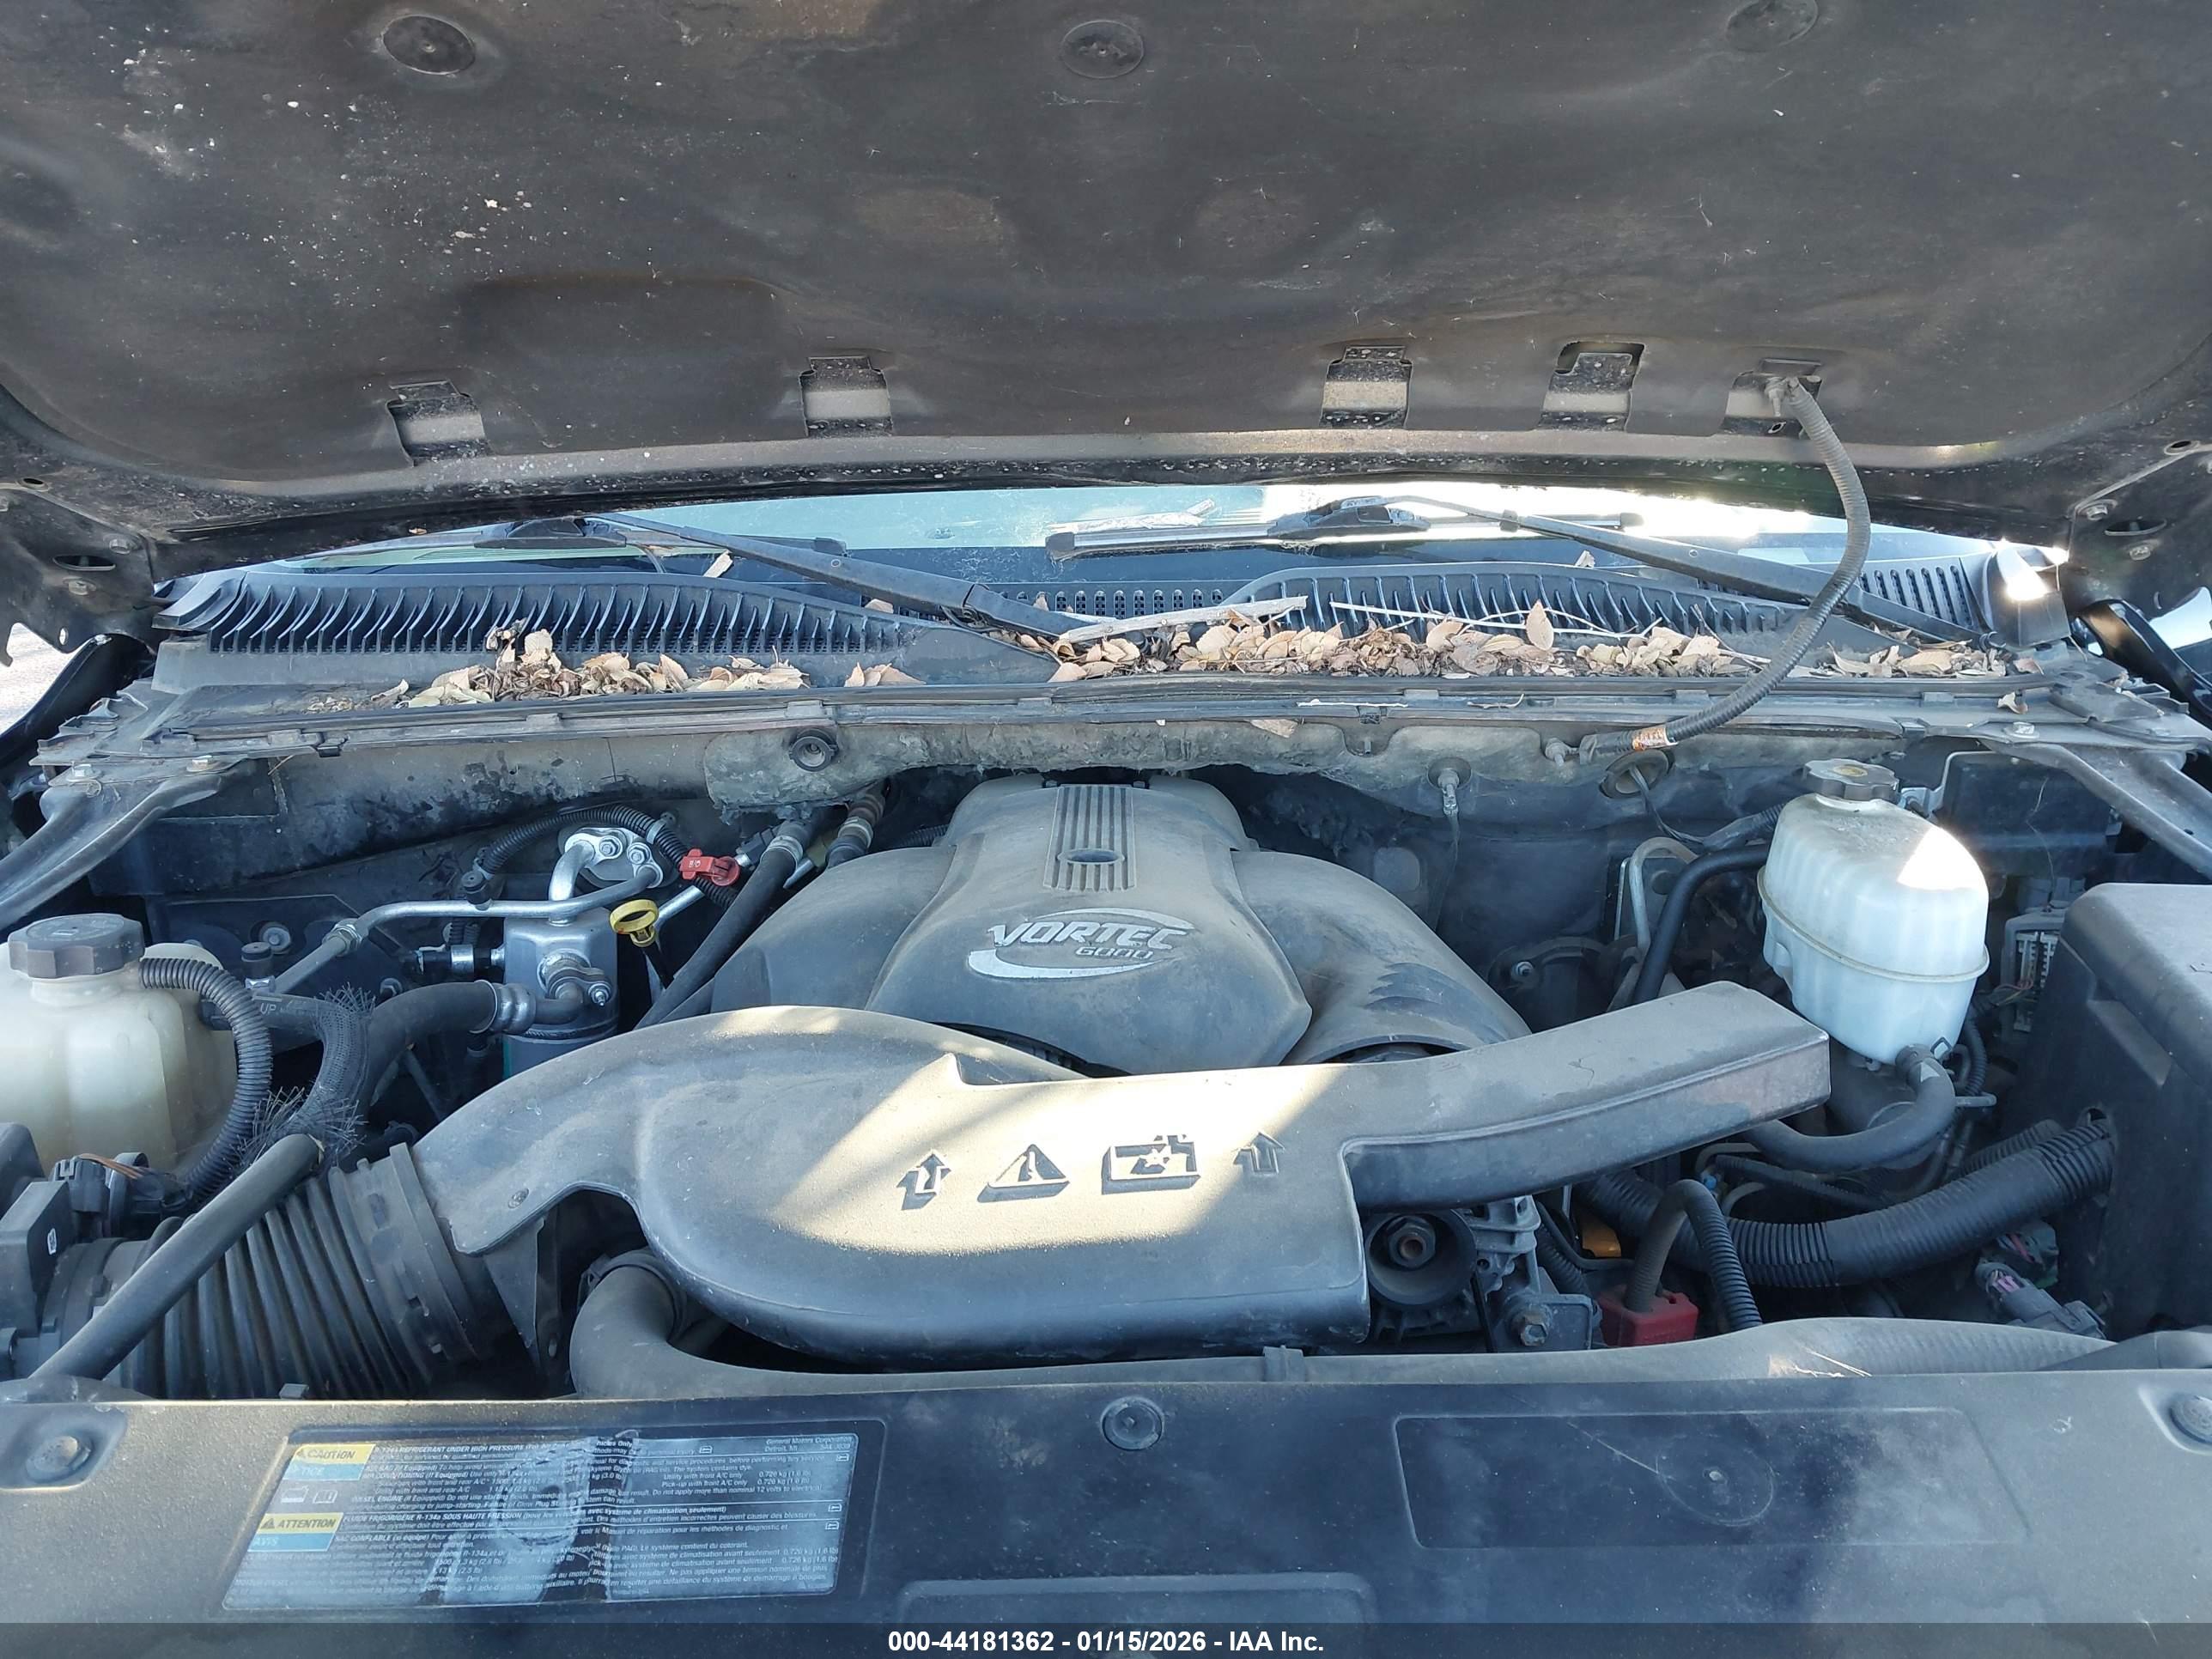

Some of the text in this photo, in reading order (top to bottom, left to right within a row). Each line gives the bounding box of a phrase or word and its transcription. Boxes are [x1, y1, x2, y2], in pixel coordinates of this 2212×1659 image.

[988, 921, 1188, 950] VORTEC
[259, 1002, 276, 1016] UP
[307, 1449, 356, 1460] CAUTION
[277, 1519, 337, 1528] ATTENTION
